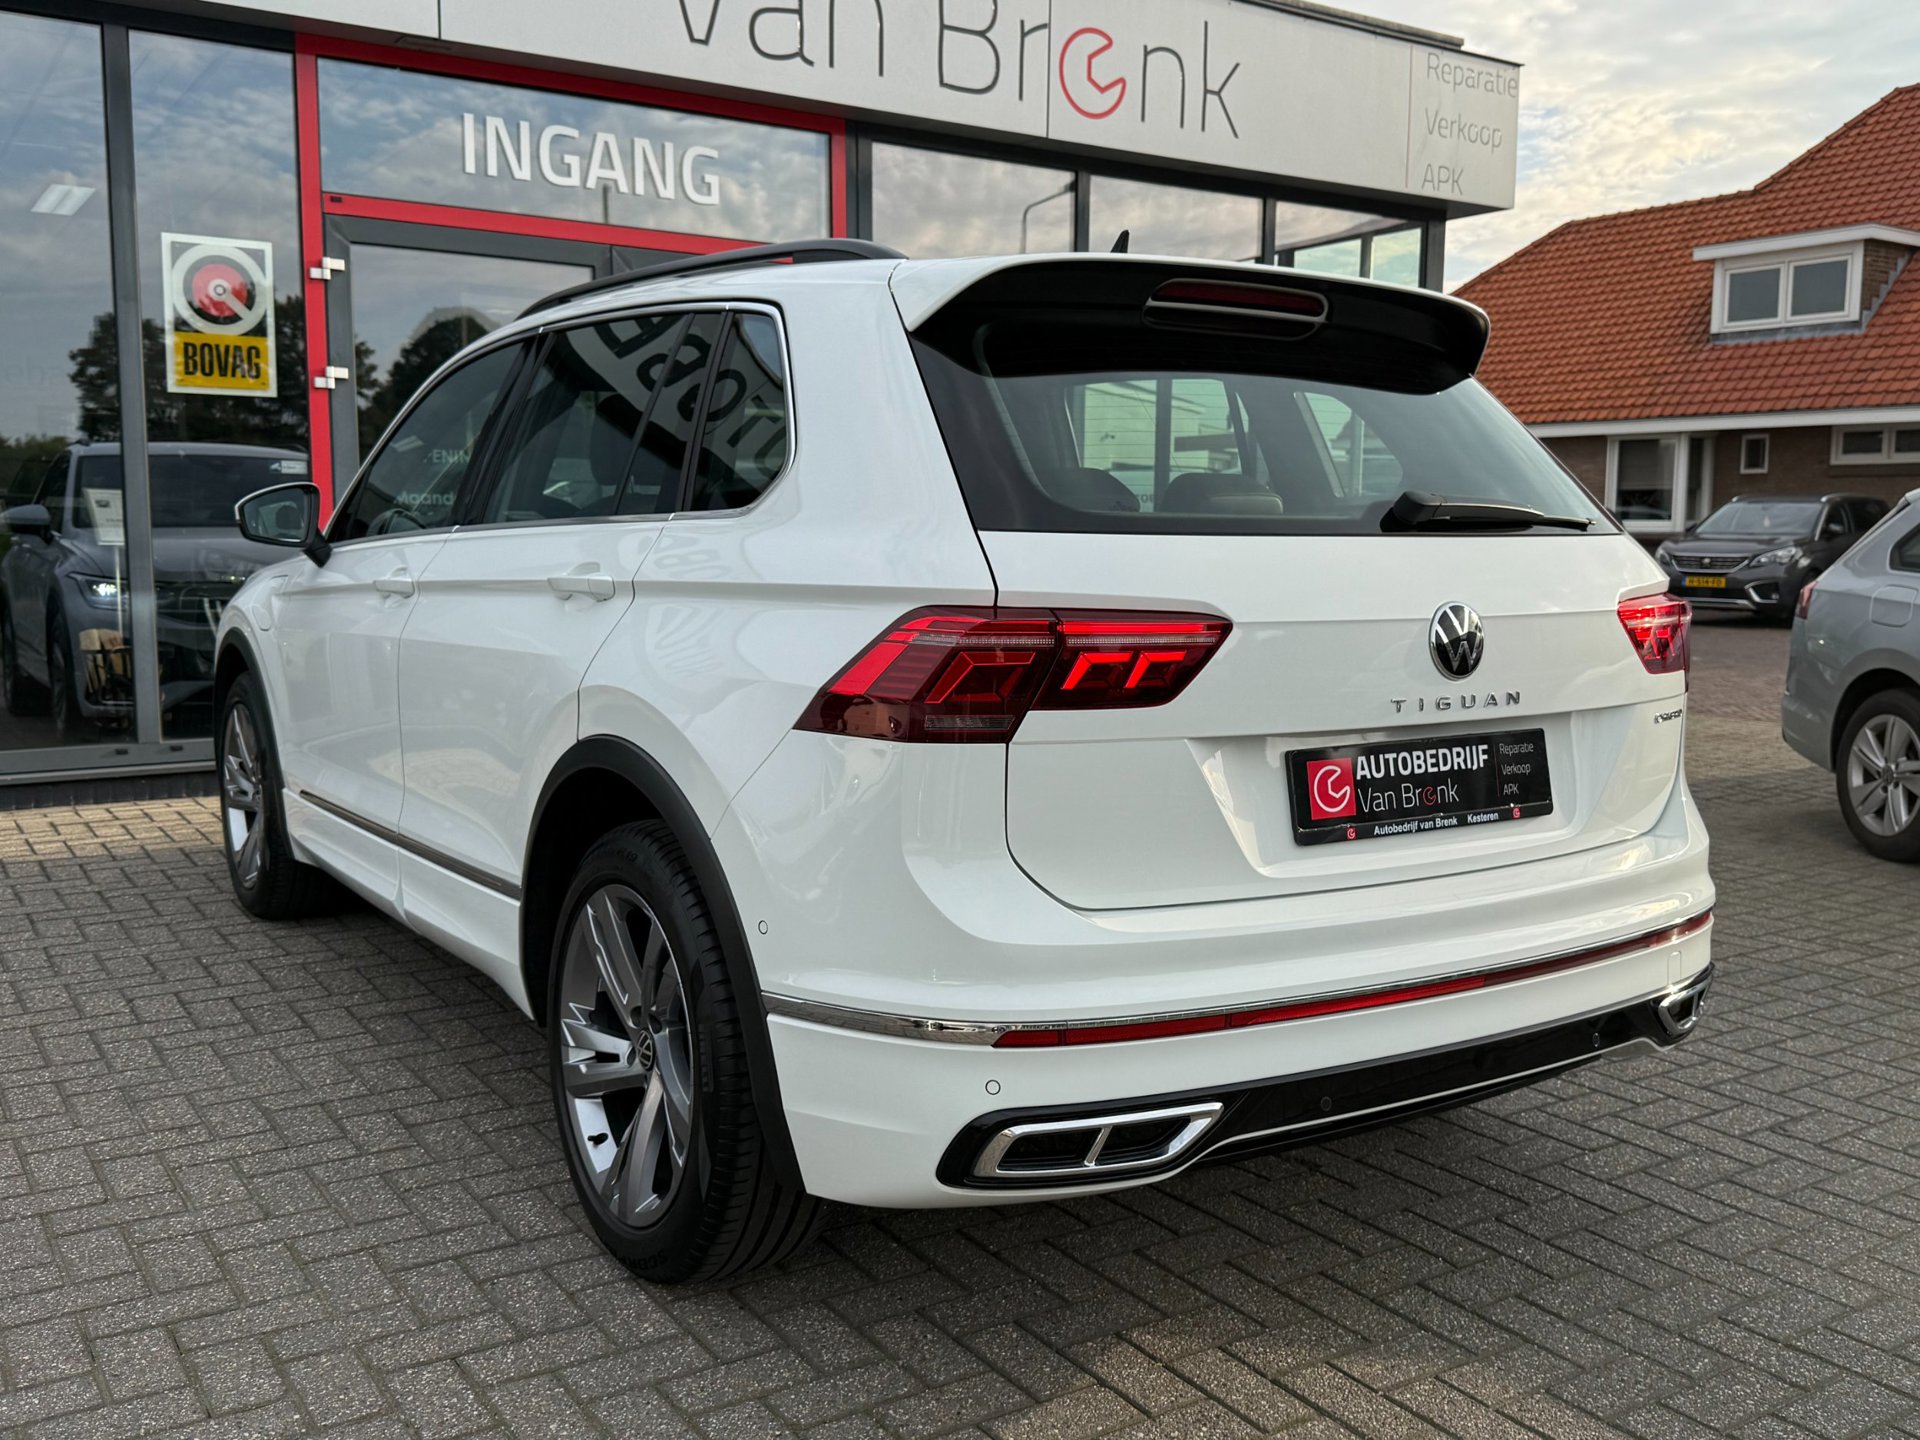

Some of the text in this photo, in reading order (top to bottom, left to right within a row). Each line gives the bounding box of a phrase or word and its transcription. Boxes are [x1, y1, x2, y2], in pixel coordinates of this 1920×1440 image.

[1426, 51, 1519, 98] Reparatie
[1424, 107, 1503, 155] Verkoop
[461, 112, 722, 207] INGANG
[1420, 162, 1465, 196] APK
[183, 341, 262, 380] BOVAG
[1390, 689, 1521, 714] TIGUAN
[1356, 743, 1489, 781] AUTOBEDRIJF
[1499, 742, 1534, 757] Reparatie
[1501, 762, 1531, 776] Verkoop
[1357, 778, 1459, 813] Van Brenk
[1503, 783, 1519, 796] APK
[1374, 811, 1499, 836] Autobedrijf van Brenk Kesteren
